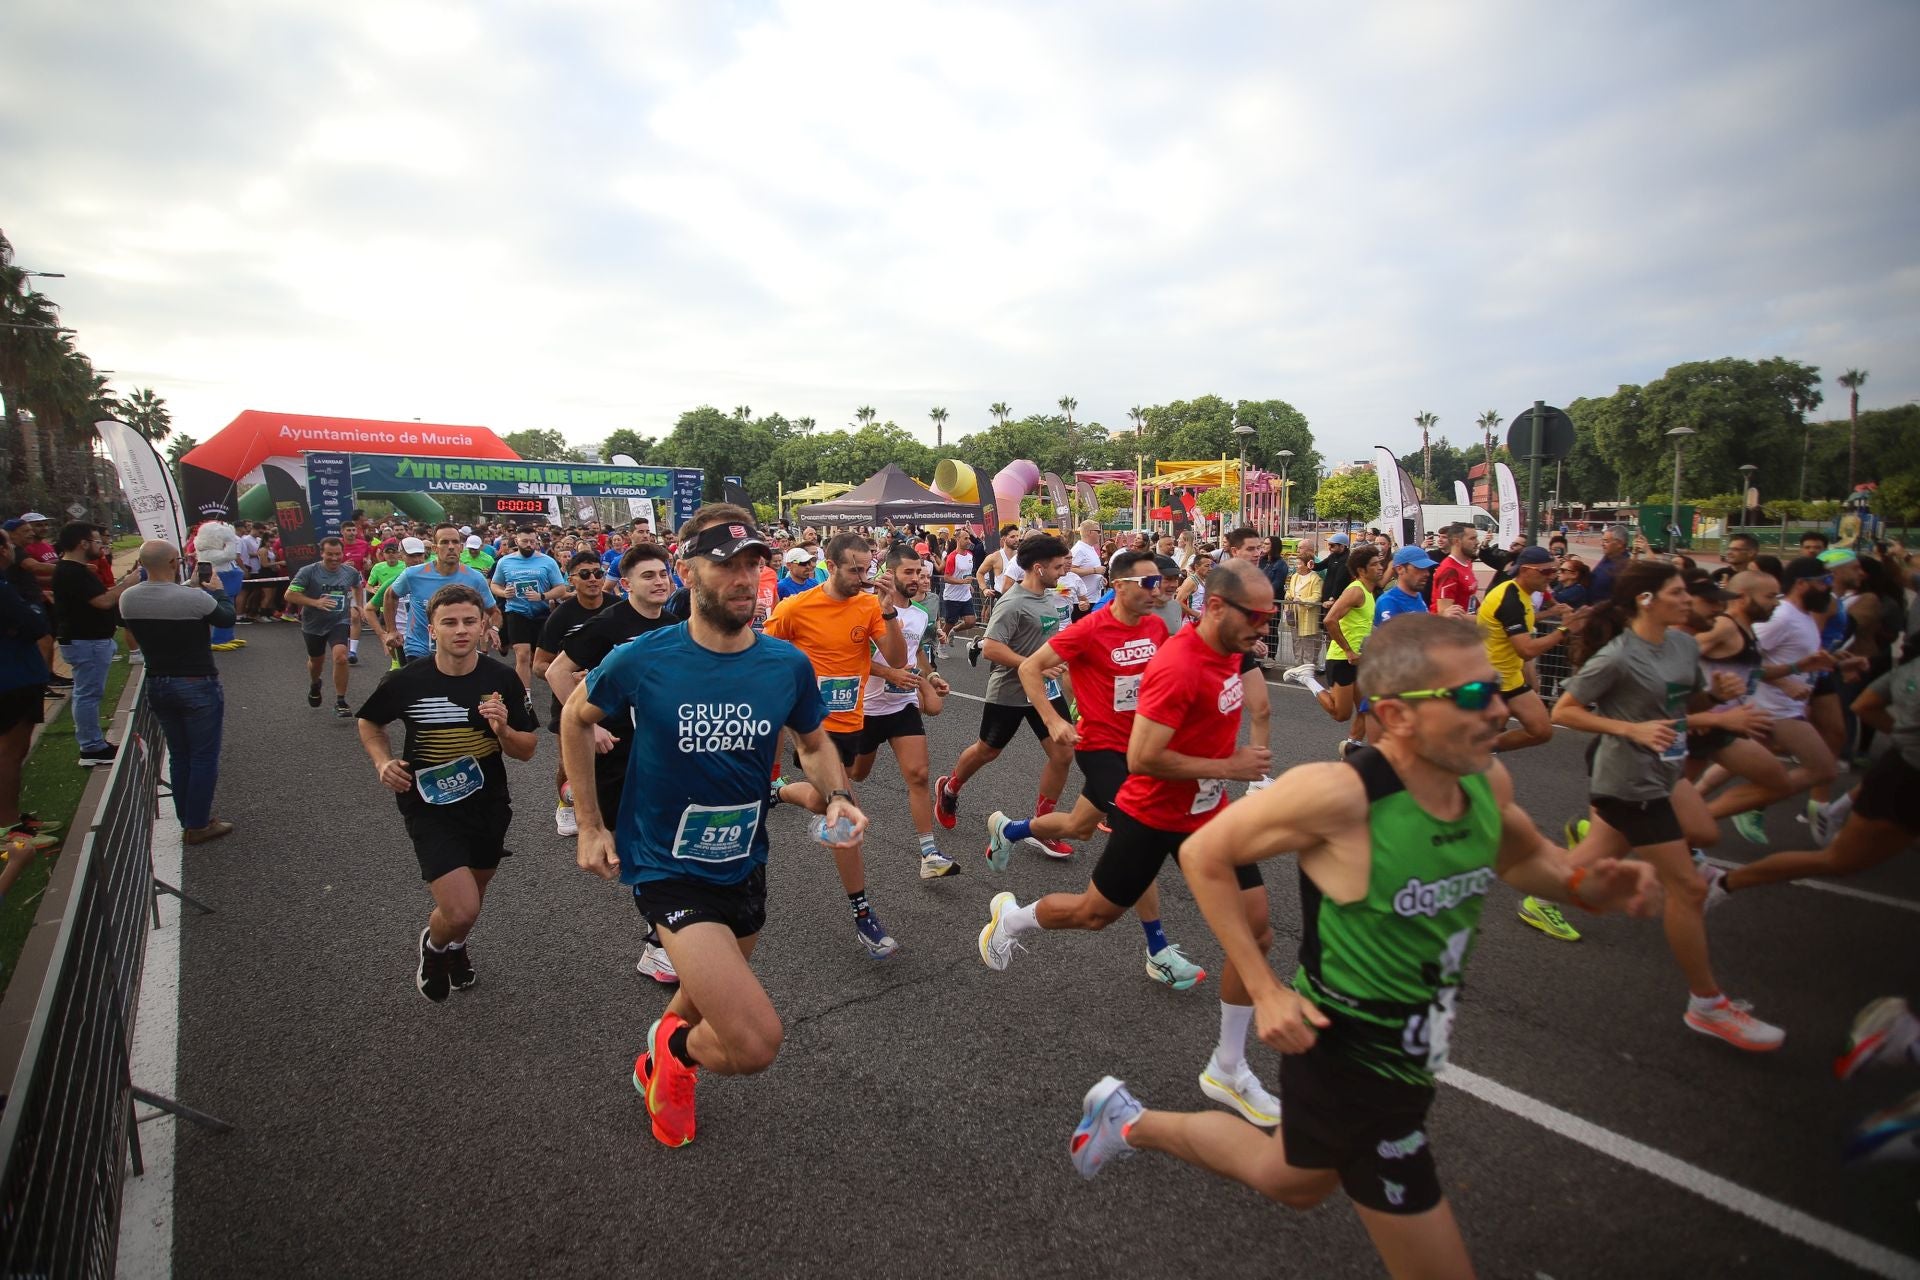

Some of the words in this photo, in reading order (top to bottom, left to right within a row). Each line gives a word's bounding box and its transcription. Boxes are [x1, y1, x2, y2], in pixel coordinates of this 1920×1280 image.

[279, 425, 396, 443] Ayuntamiento
[399, 431, 418, 444] de
[422, 432, 473, 446] Murcia
[445, 463, 542, 482] CARRERA
[545, 469, 569, 483] DE
[571, 469, 668, 487] EMPRESAS
[429, 481, 443, 490] LA
[444, 482, 487, 491] VERDAD
[518, 483, 572, 496] SALIDA
[613, 487, 647, 496] VERDAD
[497, 500, 543, 512] 0:00:03
[831, 689, 852, 700] 156
[678, 703, 752, 720] GRUPO
[678, 719, 771, 737] HOZONO
[678, 736, 756, 753] GLOBAL
[436, 772, 468, 790] 659
[701, 825, 742, 843] 579
